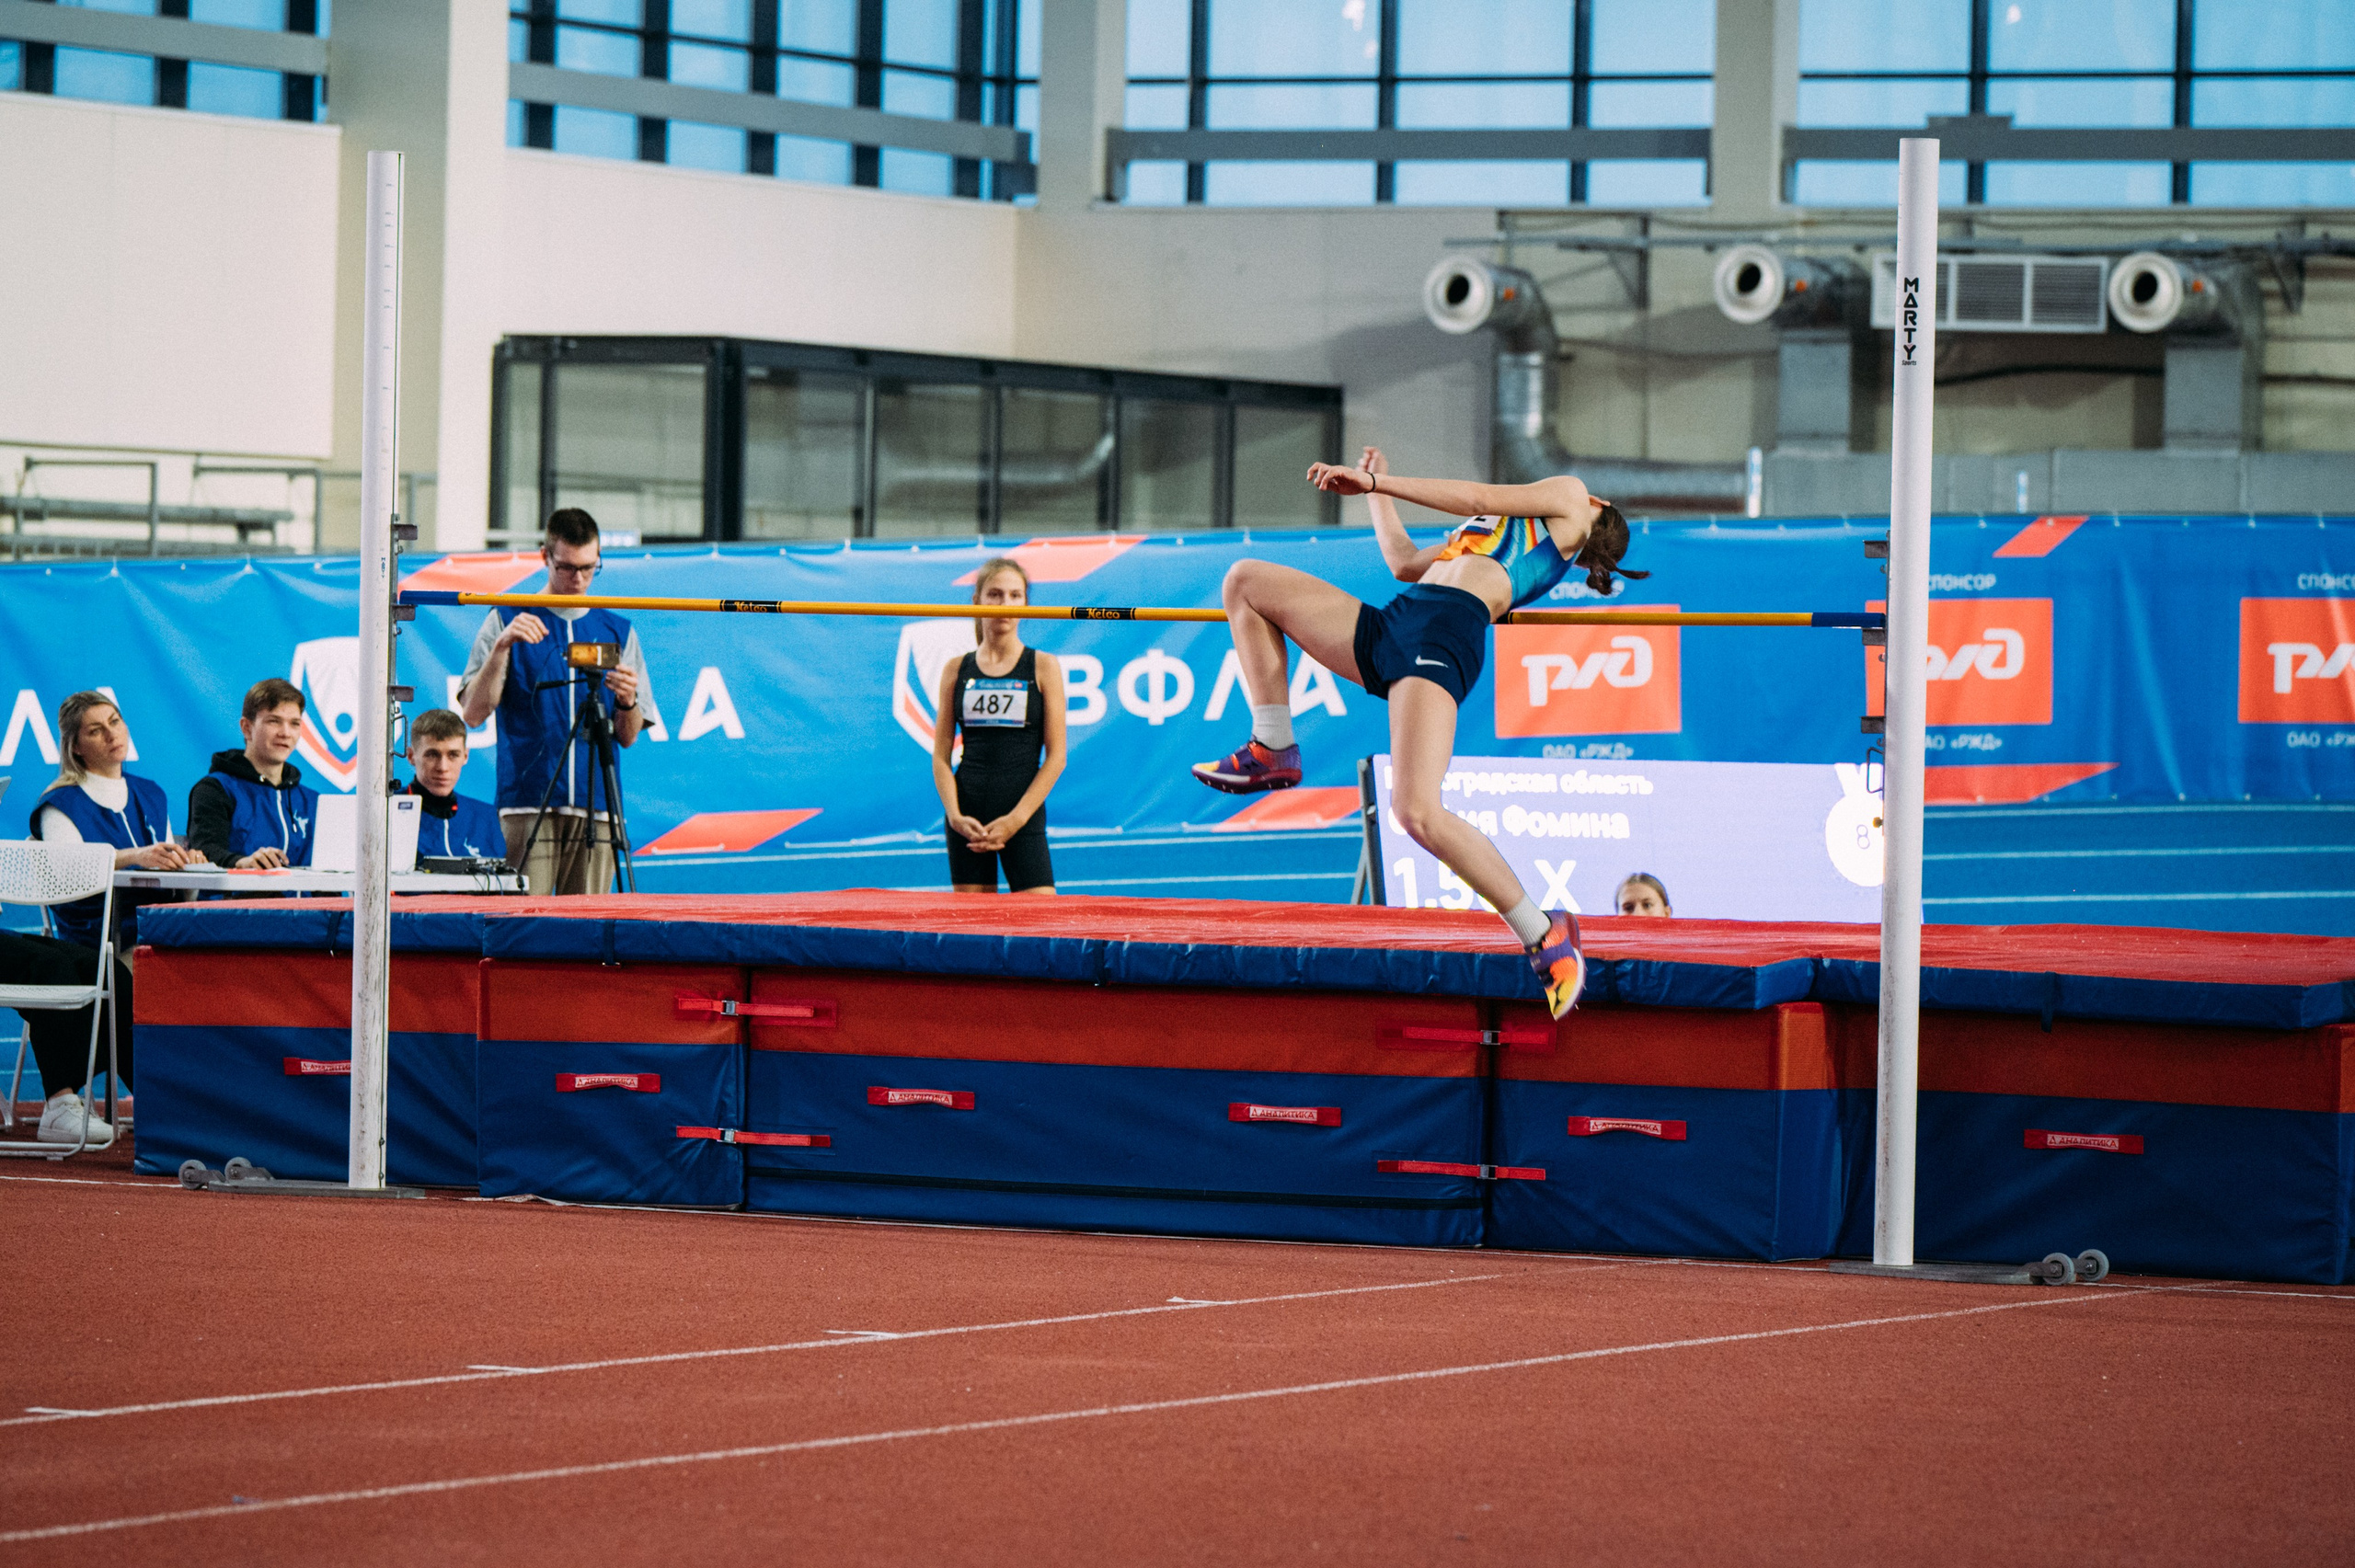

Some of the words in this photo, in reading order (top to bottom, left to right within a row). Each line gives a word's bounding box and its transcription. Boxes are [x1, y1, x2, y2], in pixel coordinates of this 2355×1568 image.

[1903, 277, 1919, 360] MARTY
[972, 694, 1014, 715] 487
[1560, 770, 1653, 795] область
[1502, 805, 1630, 839] Фомина
[1856, 824, 1870, 850] 8
